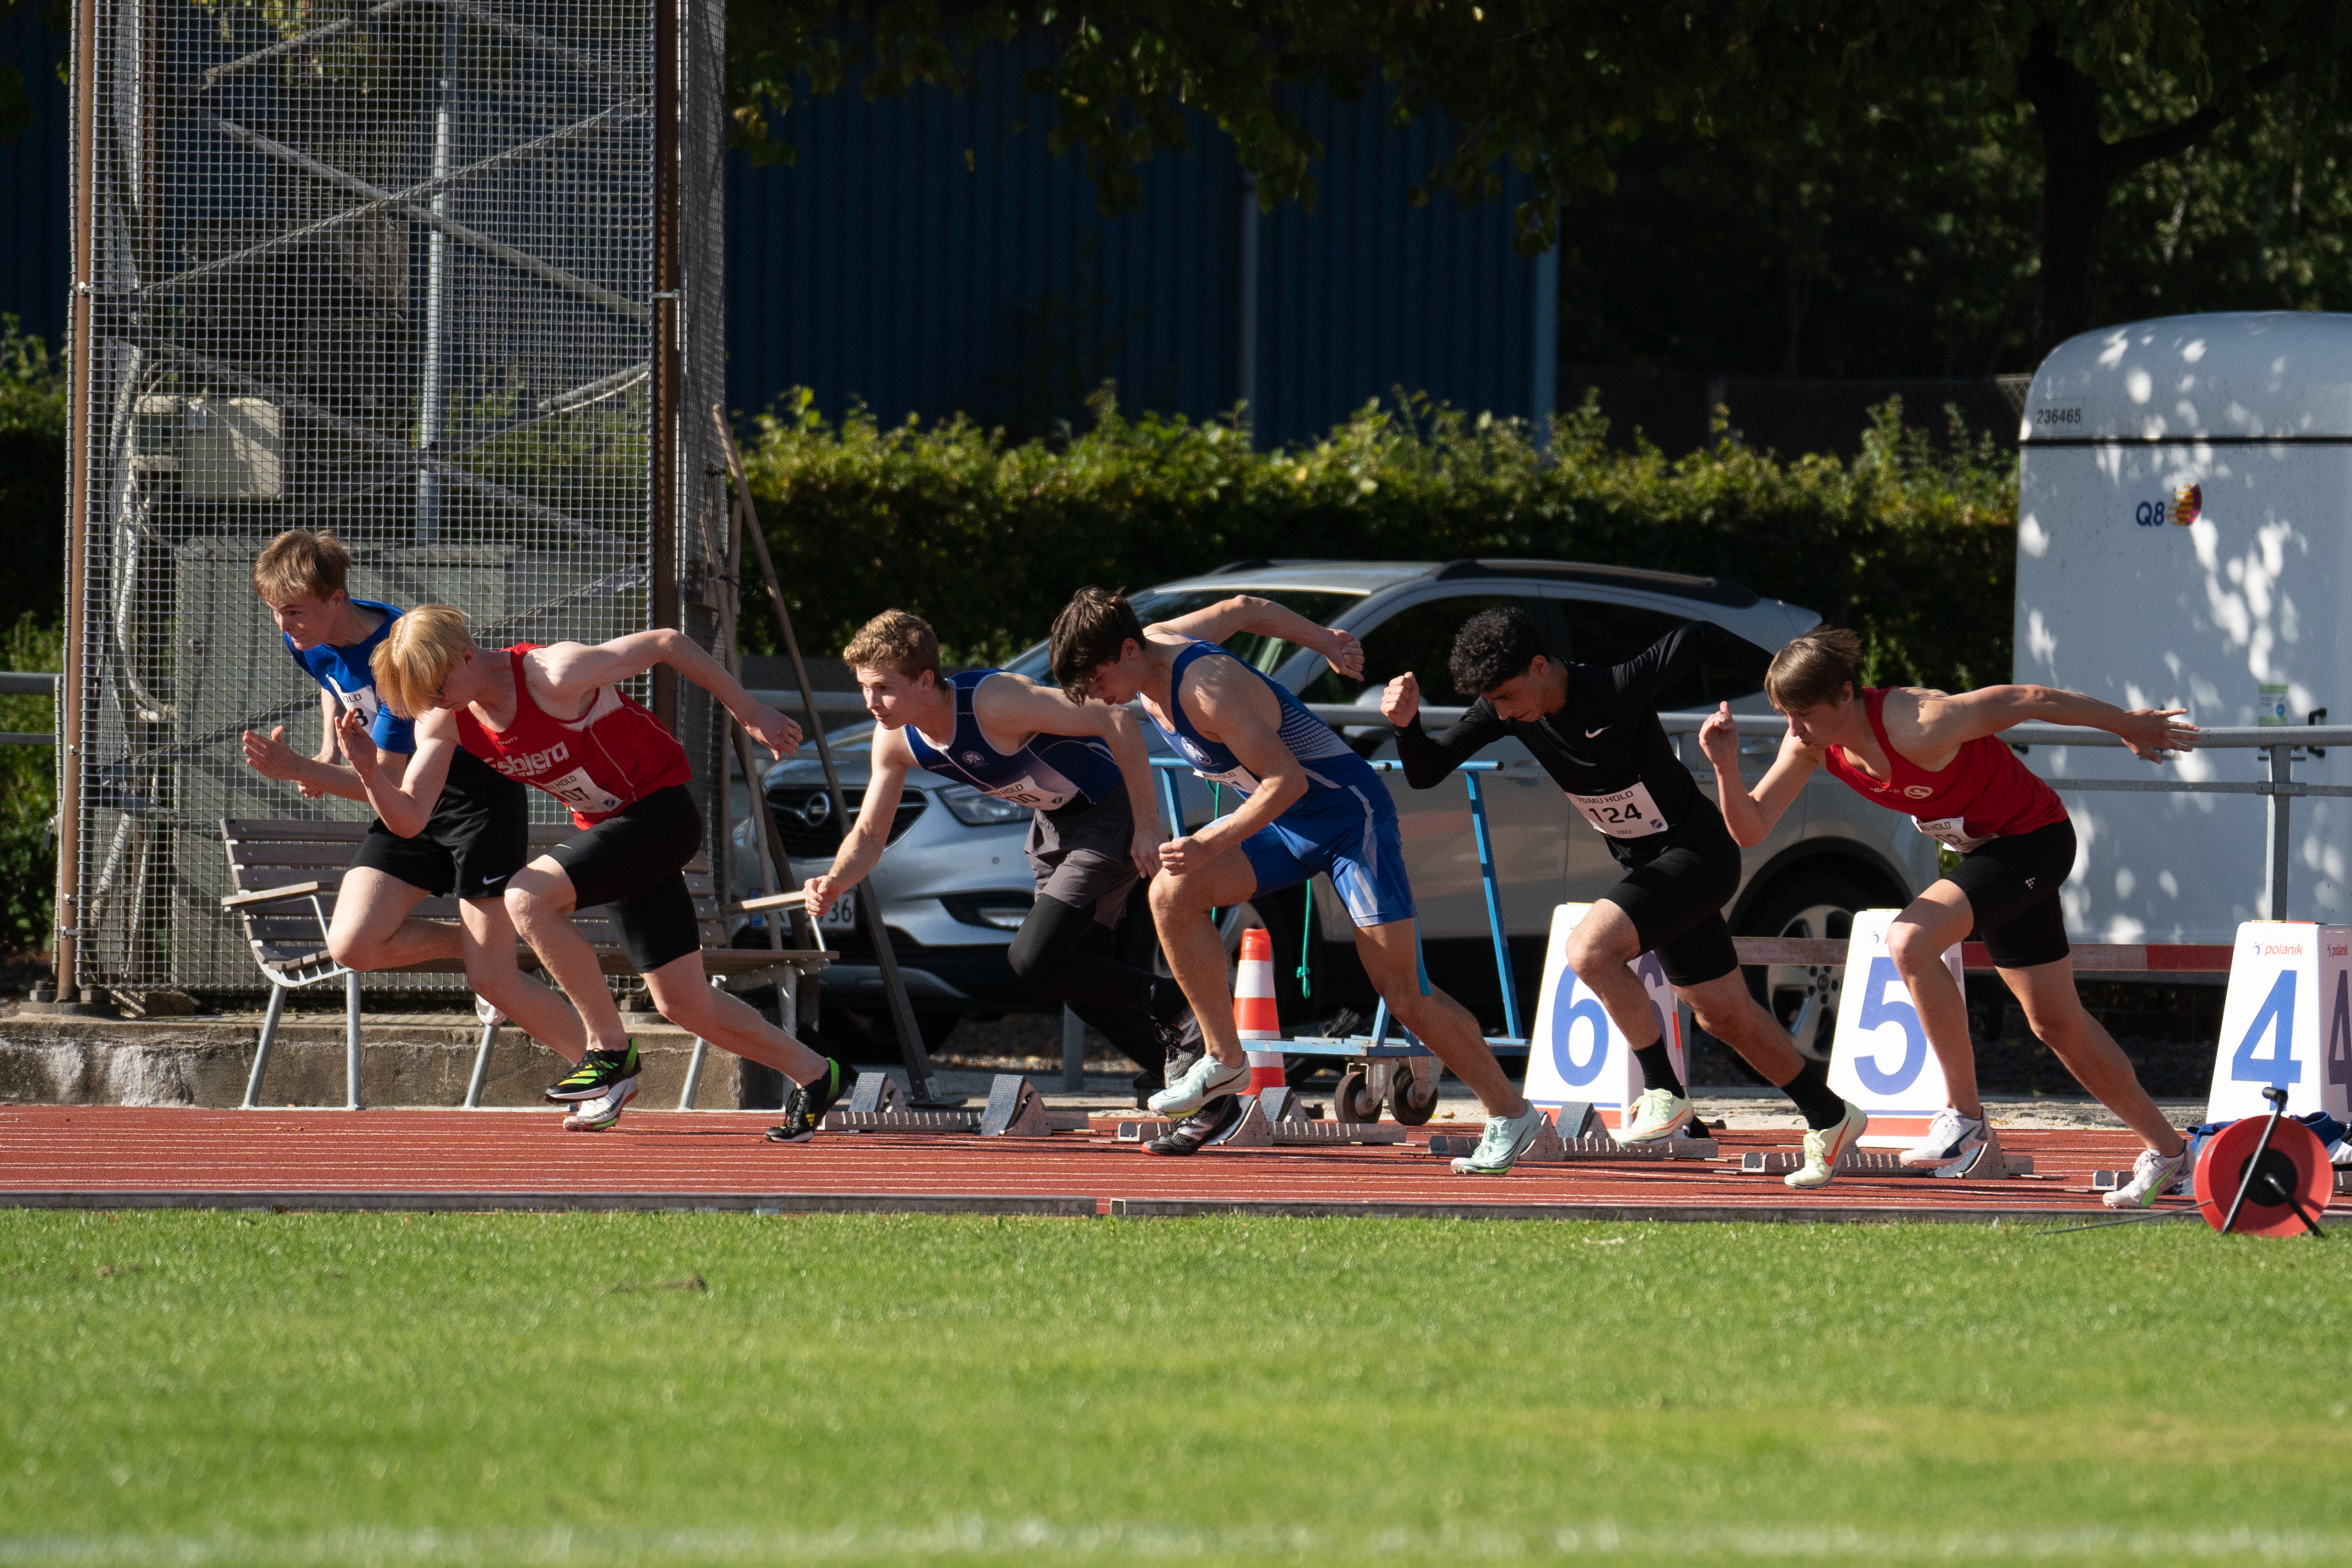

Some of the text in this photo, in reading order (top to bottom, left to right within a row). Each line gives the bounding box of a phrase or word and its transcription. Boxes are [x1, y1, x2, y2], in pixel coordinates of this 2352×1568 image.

[2036, 408, 2081, 424] 236465
[2136, 501, 2165, 527] Q8
[342, 693, 362, 703] OLD
[555, 775, 577, 788] HOLD
[1000, 783, 1024, 794] HOLD
[551, 787, 590, 803] 107
[1005, 793, 1041, 804] 00
[1605, 791, 1634, 803] HOLD
[1588, 803, 1642, 824] 124
[1931, 821, 1951, 831] HOLD
[1934, 834, 1970, 845] 02
[2264, 943, 2303, 957] polanik
[1552, 963, 1609, 1087] 6
[1854, 957, 1927, 1096] 5
[2231, 970, 2302, 1111] 4
[2328, 969, 2352, 1113] 4
